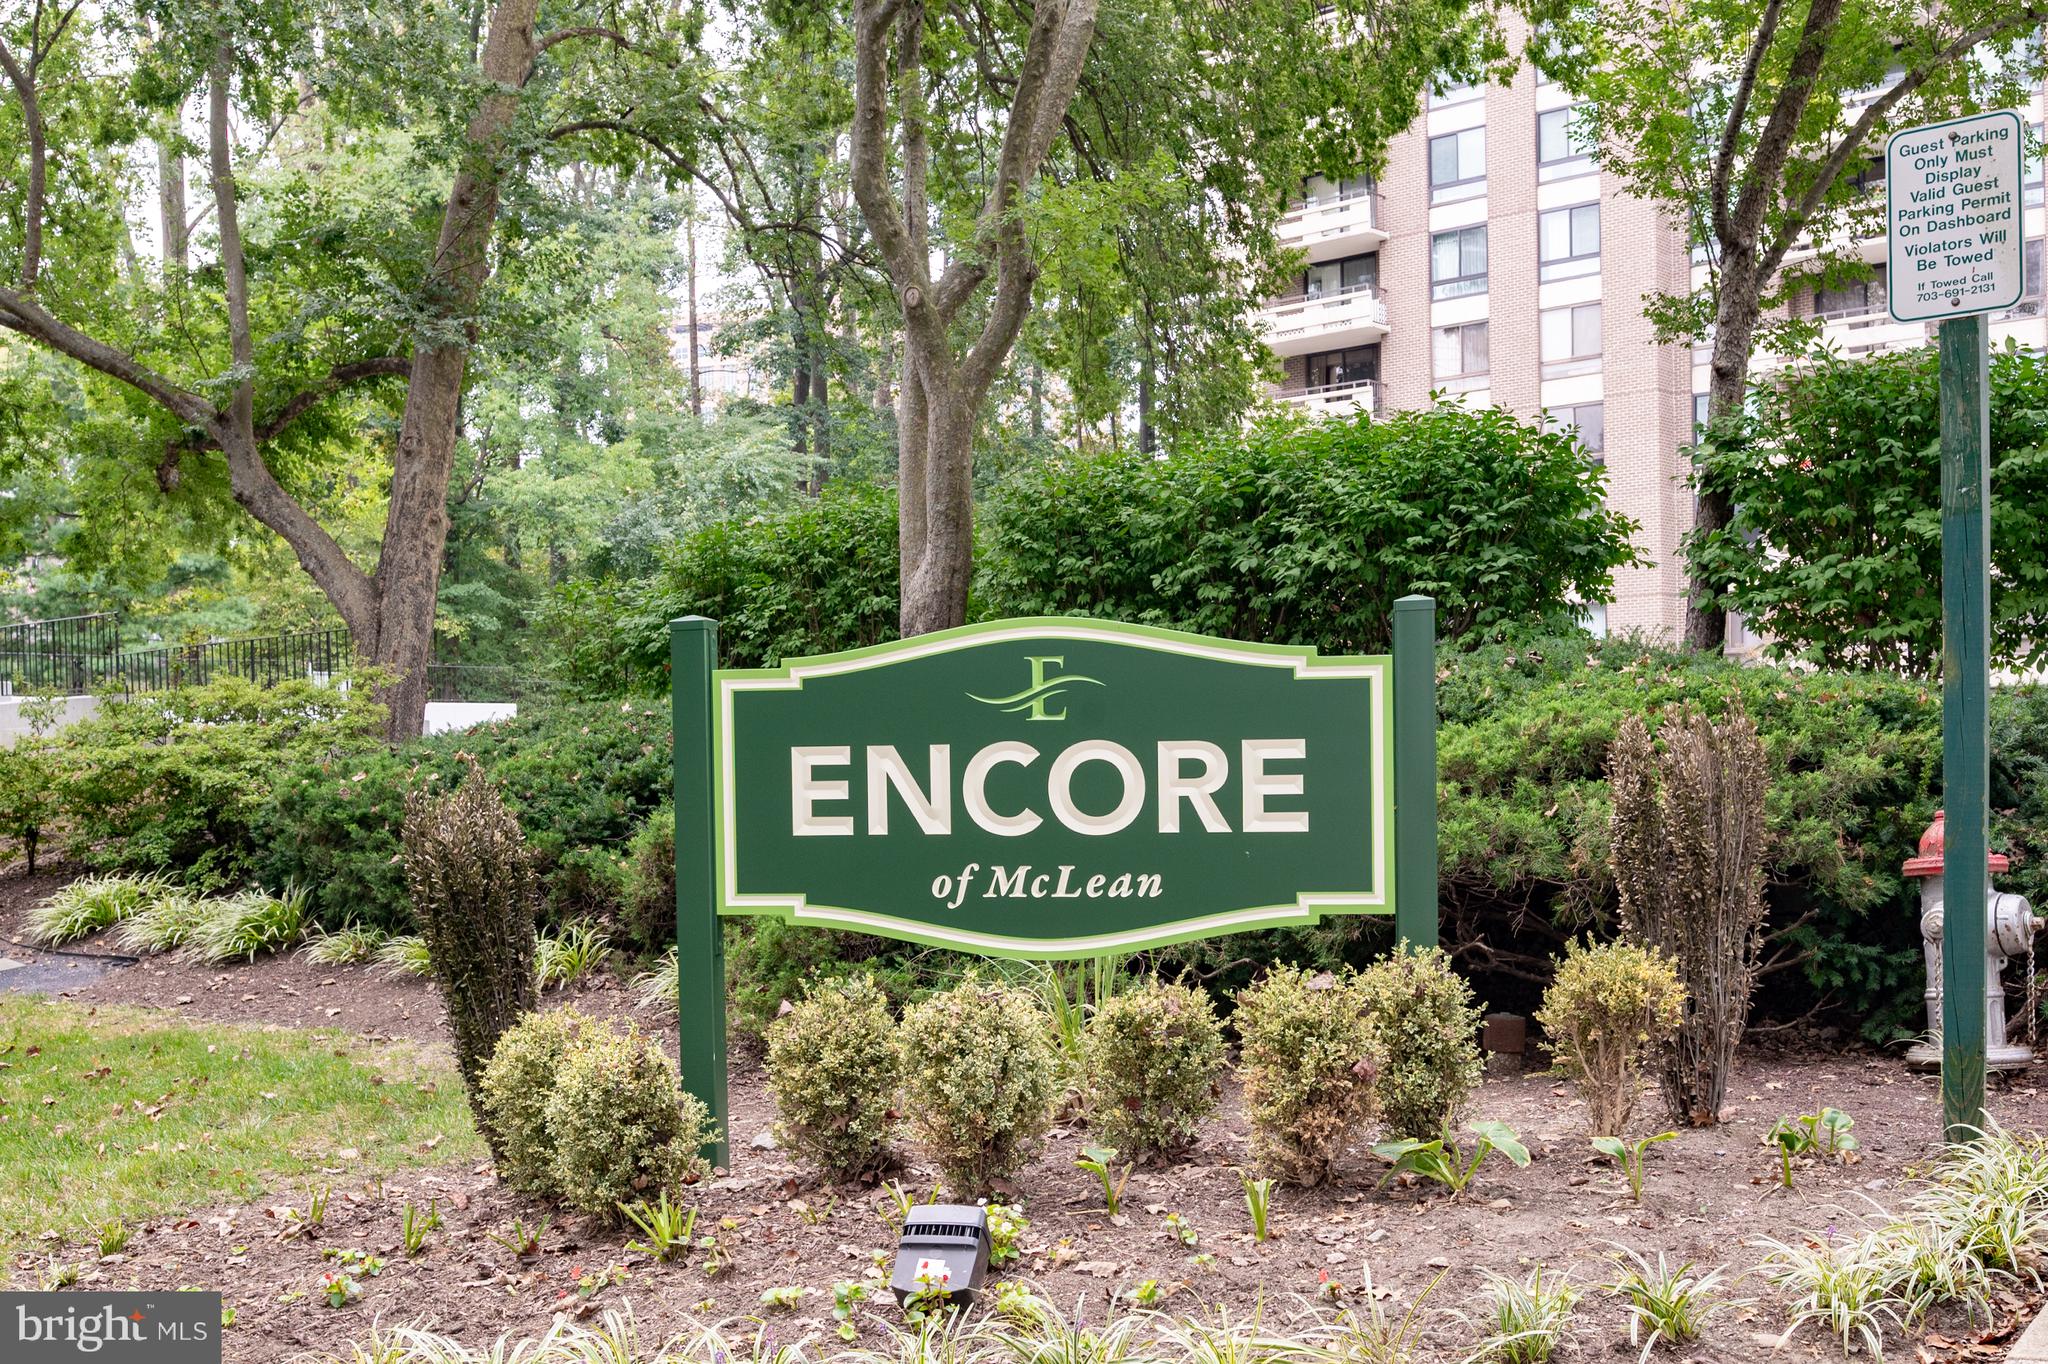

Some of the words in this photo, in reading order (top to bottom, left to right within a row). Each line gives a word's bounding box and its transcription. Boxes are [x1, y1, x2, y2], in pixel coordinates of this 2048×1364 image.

[1899, 138, 1945, 157] Guest
[1952, 127, 2009, 147] Parking
[1914, 154, 1948, 171] Only
[1955, 145, 1993, 163] Must
[1925, 165, 1982, 185] Display
[1910, 186, 1945, 203] Valid
[1952, 177, 1999, 196] Guest
[1898, 202, 1954, 221] Parking
[1961, 192, 2011, 210] Permit
[1899, 222, 1920, 237] On
[1927, 207, 2011, 233] Dashboard
[1905, 236, 1972, 257] Violators
[1979, 229, 2007, 245] Will
[1917, 259, 1937, 272] Be
[1944, 248, 1994, 267] Towed
[1917, 283, 1996, 302] 703-691-2131
[1918, 282, 1925, 291] If
[1930, 276, 1967, 290] Towed
[1972, 272, 1994, 283] Call
[791, 738, 1309, 836] ENCORE
[932, 863, 980, 909] of
[983, 865, 1163, 899] McLean
